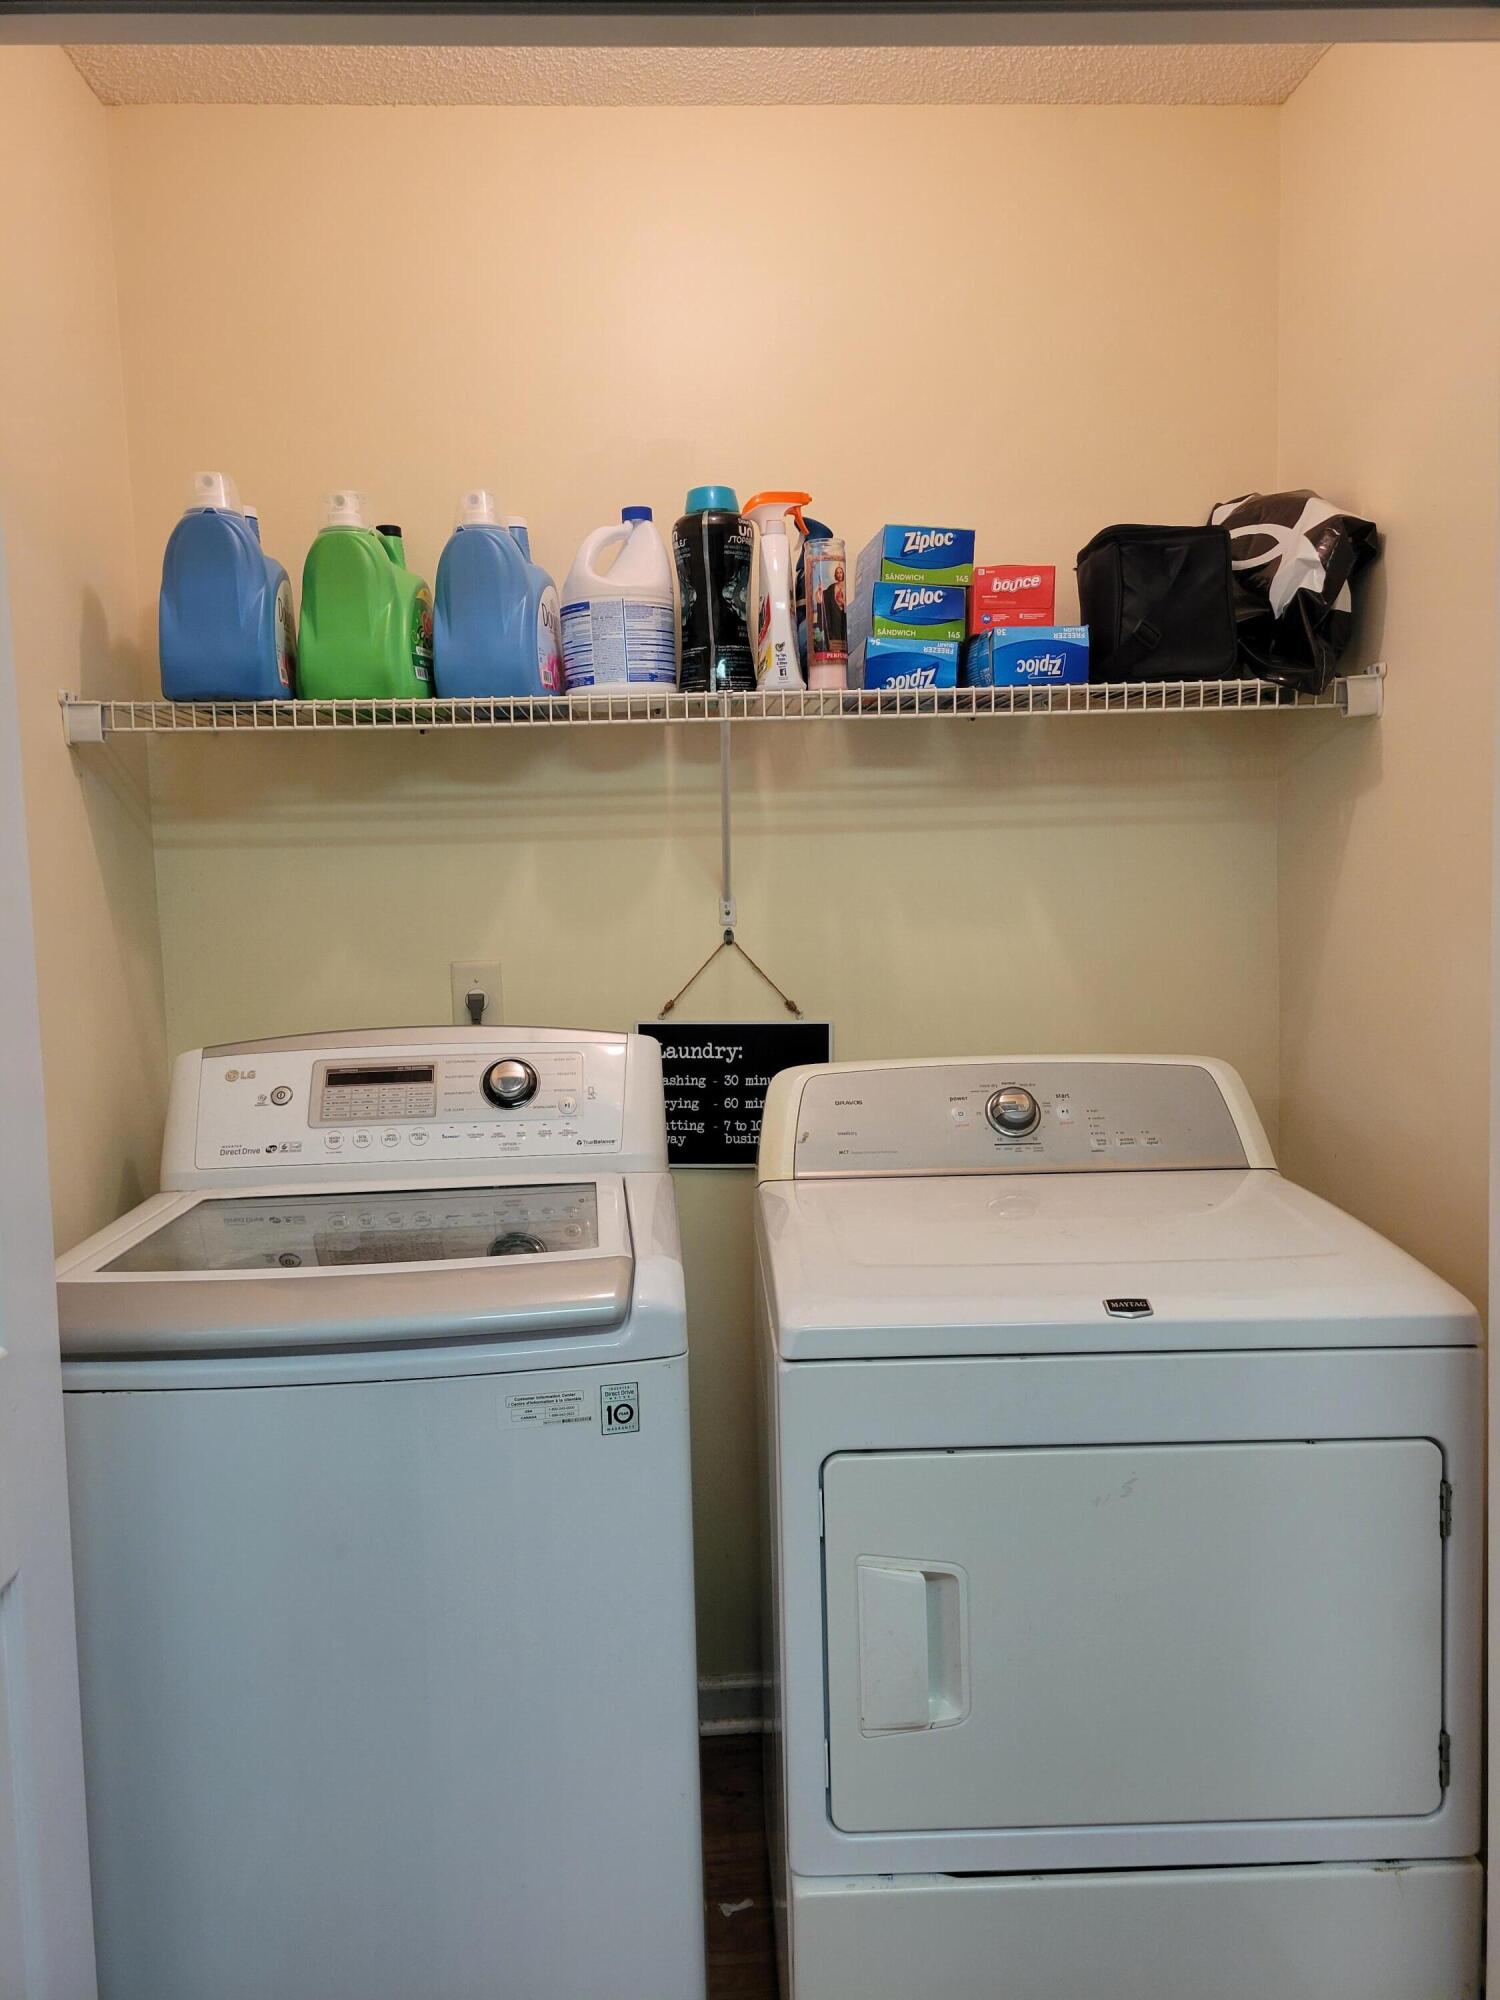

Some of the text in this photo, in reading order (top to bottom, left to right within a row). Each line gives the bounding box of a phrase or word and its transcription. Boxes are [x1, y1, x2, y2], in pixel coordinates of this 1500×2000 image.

[904, 530, 954, 553] Ziploc
[885, 573, 924, 581] SANDWICH
[992, 575, 1041, 592] bounce
[894, 588, 944, 610] Ziploc
[877, 628, 960, 639] SANDWICH 145
[923, 647, 954, 655] FREEZER
[1016, 654, 1062, 676] Ziploc
[885, 667, 937, 689] Ziploc
[240, 1070, 256, 1080] LG
[663, 1074, 706, 1088] ashing
[724, 1074, 739, 1086] 30
[664, 1097, 699, 1111] rying
[724, 1097, 739, 1108] 60
[745, 1097, 765, 1108] min
[723, 1120, 731, 1131] 7
[734, 1120, 747, 1131] to
[724, 1133, 760, 1144] busin
[220, 1148, 240, 1156] Direct
[606, 1403, 634, 1425] 10
